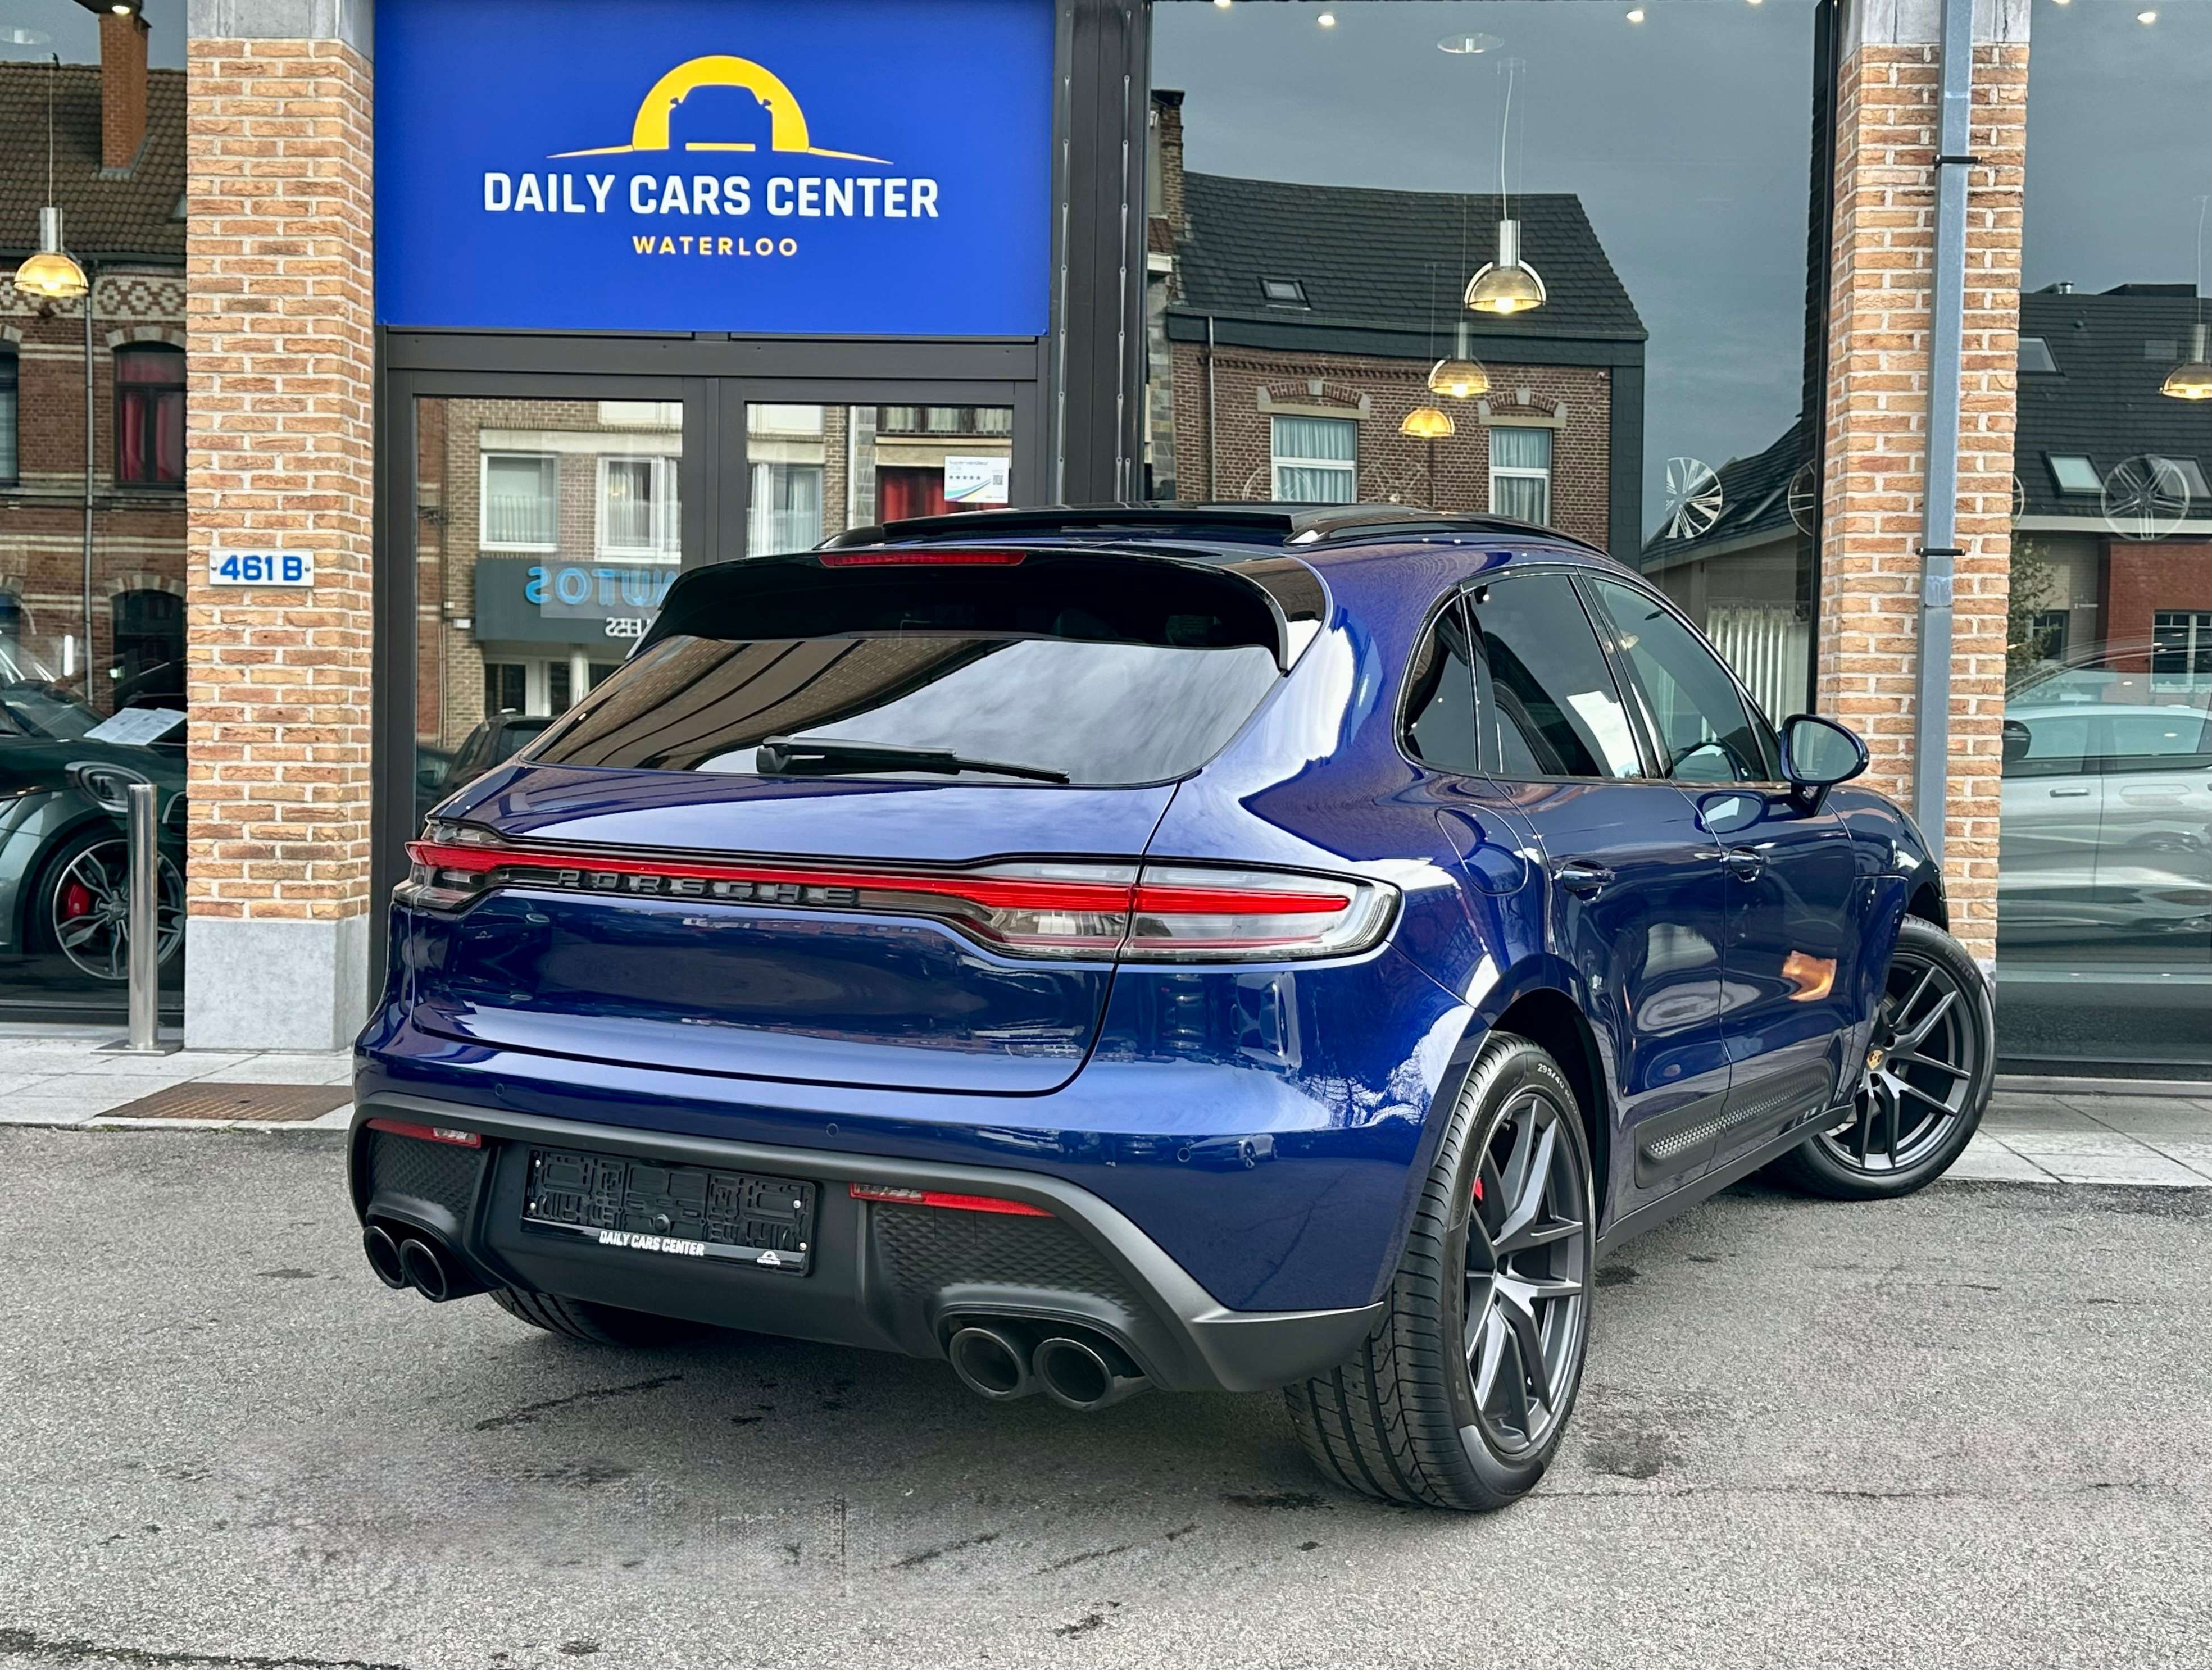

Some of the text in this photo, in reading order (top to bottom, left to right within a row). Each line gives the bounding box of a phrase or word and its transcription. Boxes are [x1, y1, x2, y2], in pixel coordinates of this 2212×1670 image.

[484, 172, 939, 218] DAILY CARS CENTER
[632, 235, 798, 256] WATERLOO
[559, 869, 856, 907] PORSCHE
[599, 1230, 706, 1257] DAILY CARS CENTER
